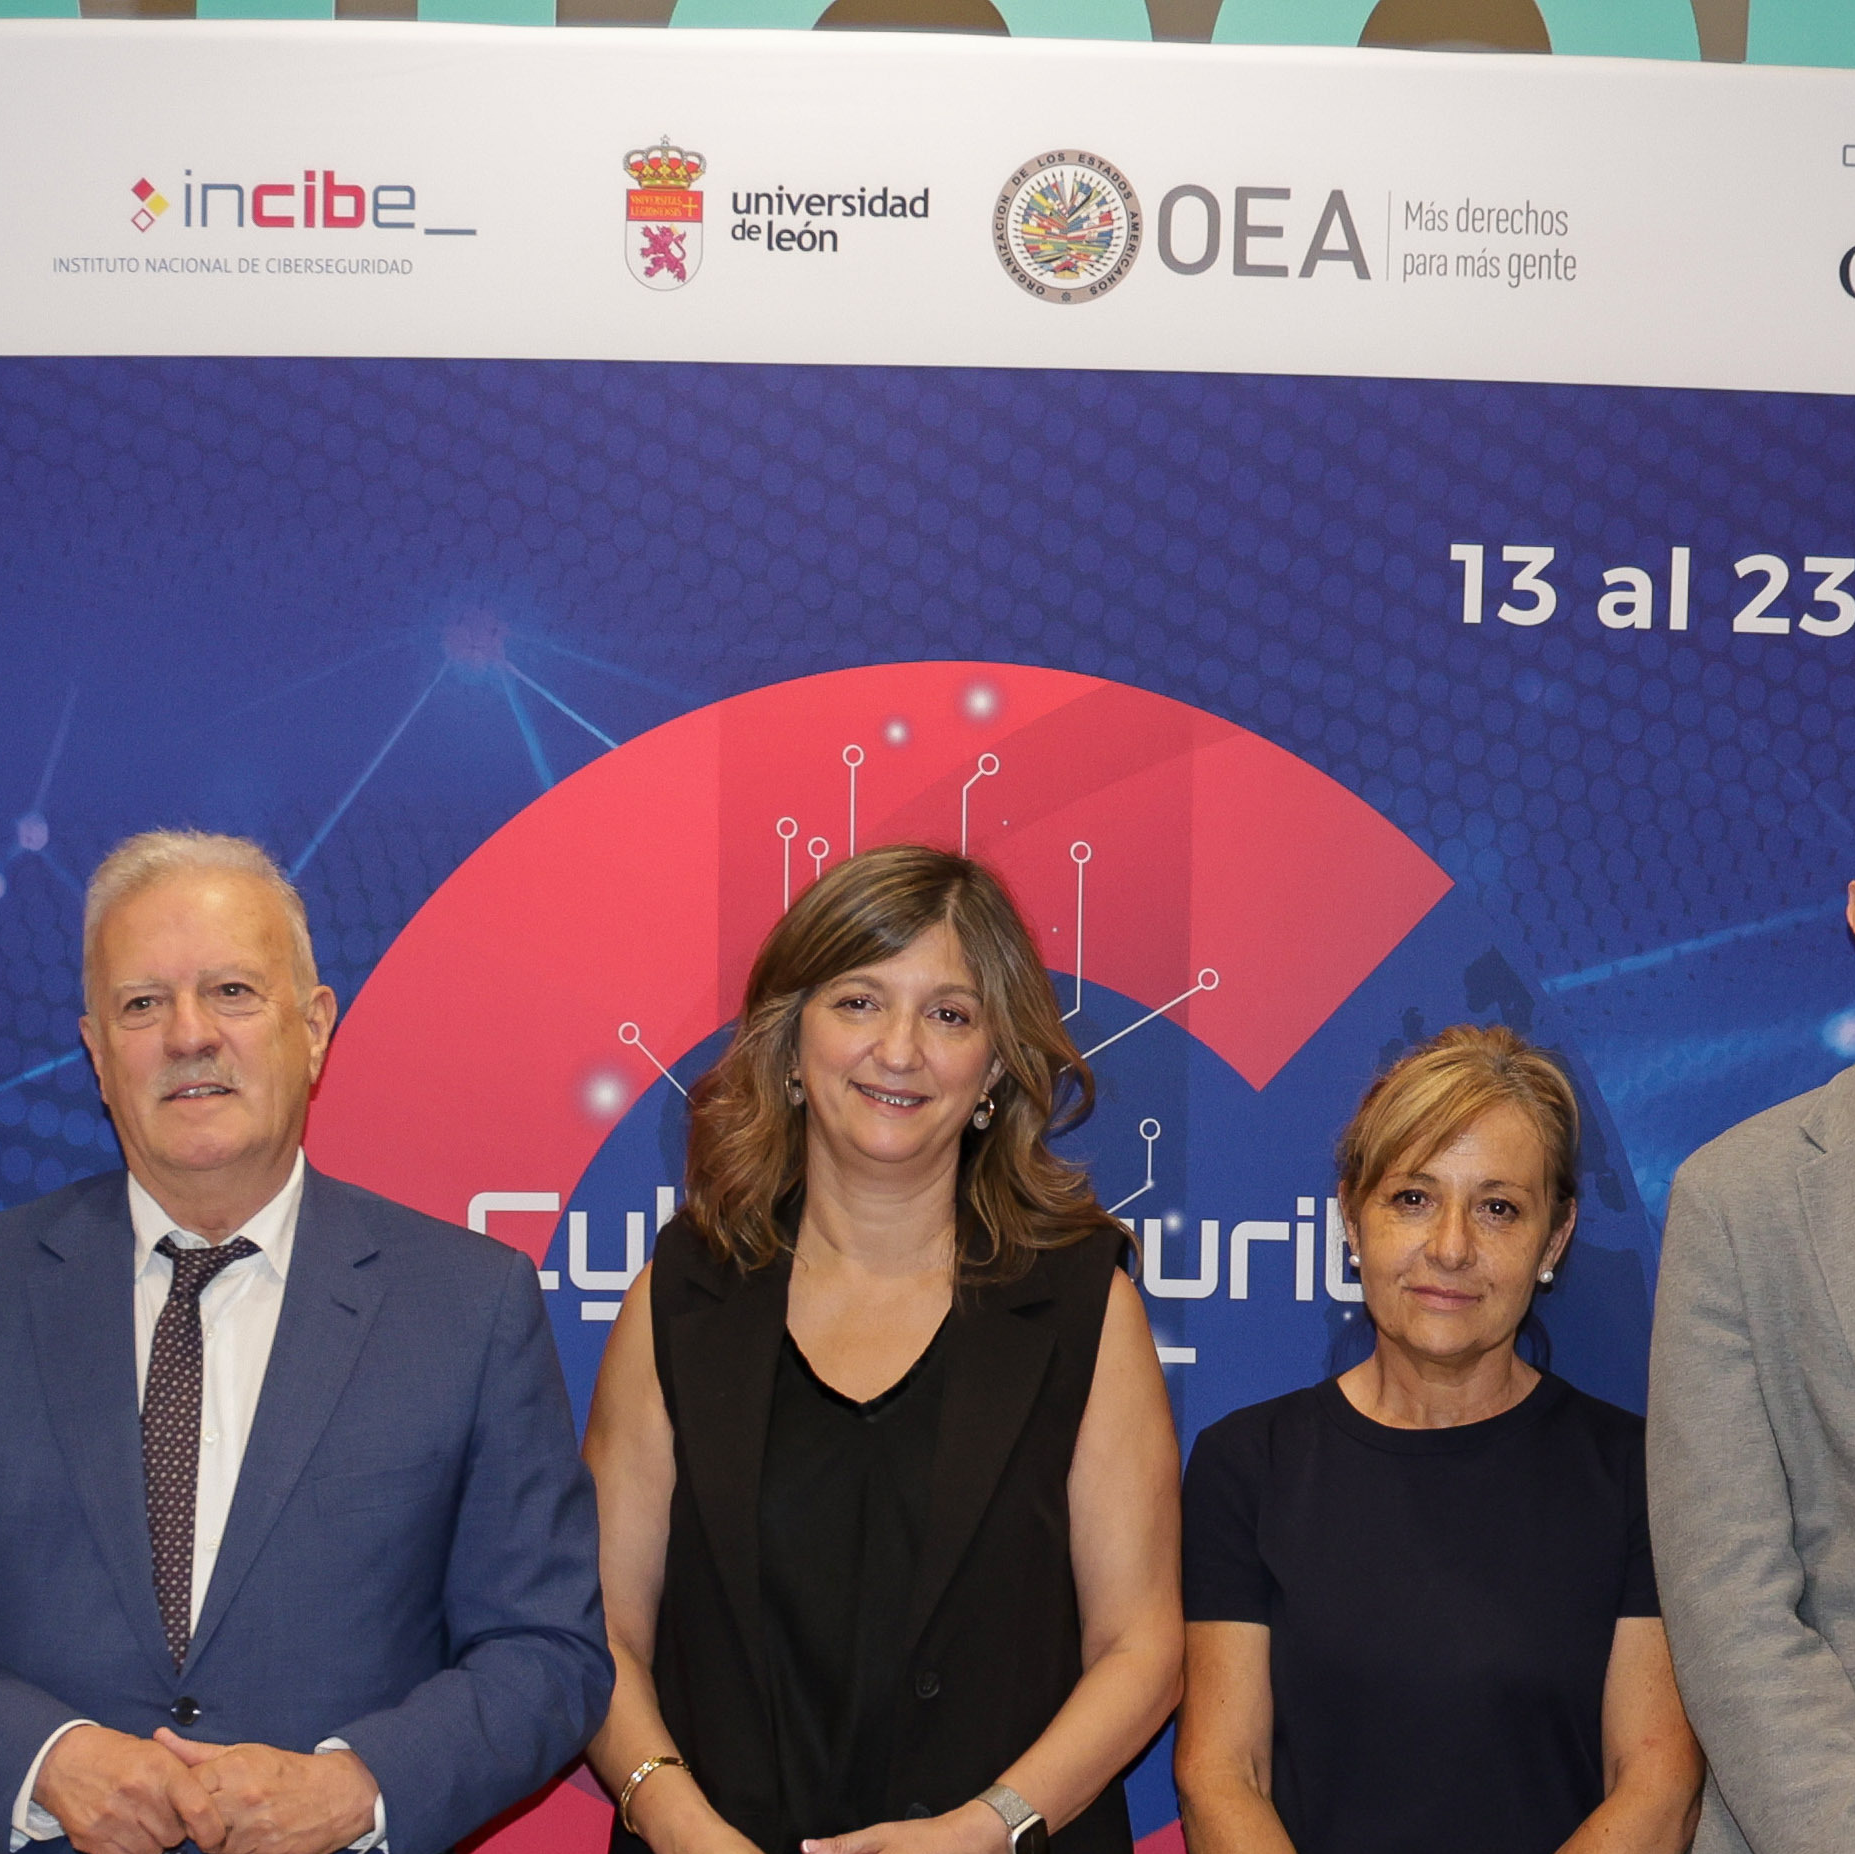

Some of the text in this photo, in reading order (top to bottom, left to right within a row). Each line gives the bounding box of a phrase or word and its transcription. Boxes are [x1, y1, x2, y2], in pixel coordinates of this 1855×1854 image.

[731, 183, 930, 219] universidad
[1403, 197, 1570, 237] Más derechos
[730, 217, 839, 253] de león
[995, 152, 1141, 296] ORGANIZACION DE LOS ESTADOS AMERICANOS
[1156, 183, 1373, 282] OEA
[52, 257, 413, 276] INSTITUTO NACIONAL DE CIBERSEGURIDAD
[1403, 246, 1578, 289] para más gente
[1449, 542, 1558, 628] 13
[1595, 545, 1691, 633] al
